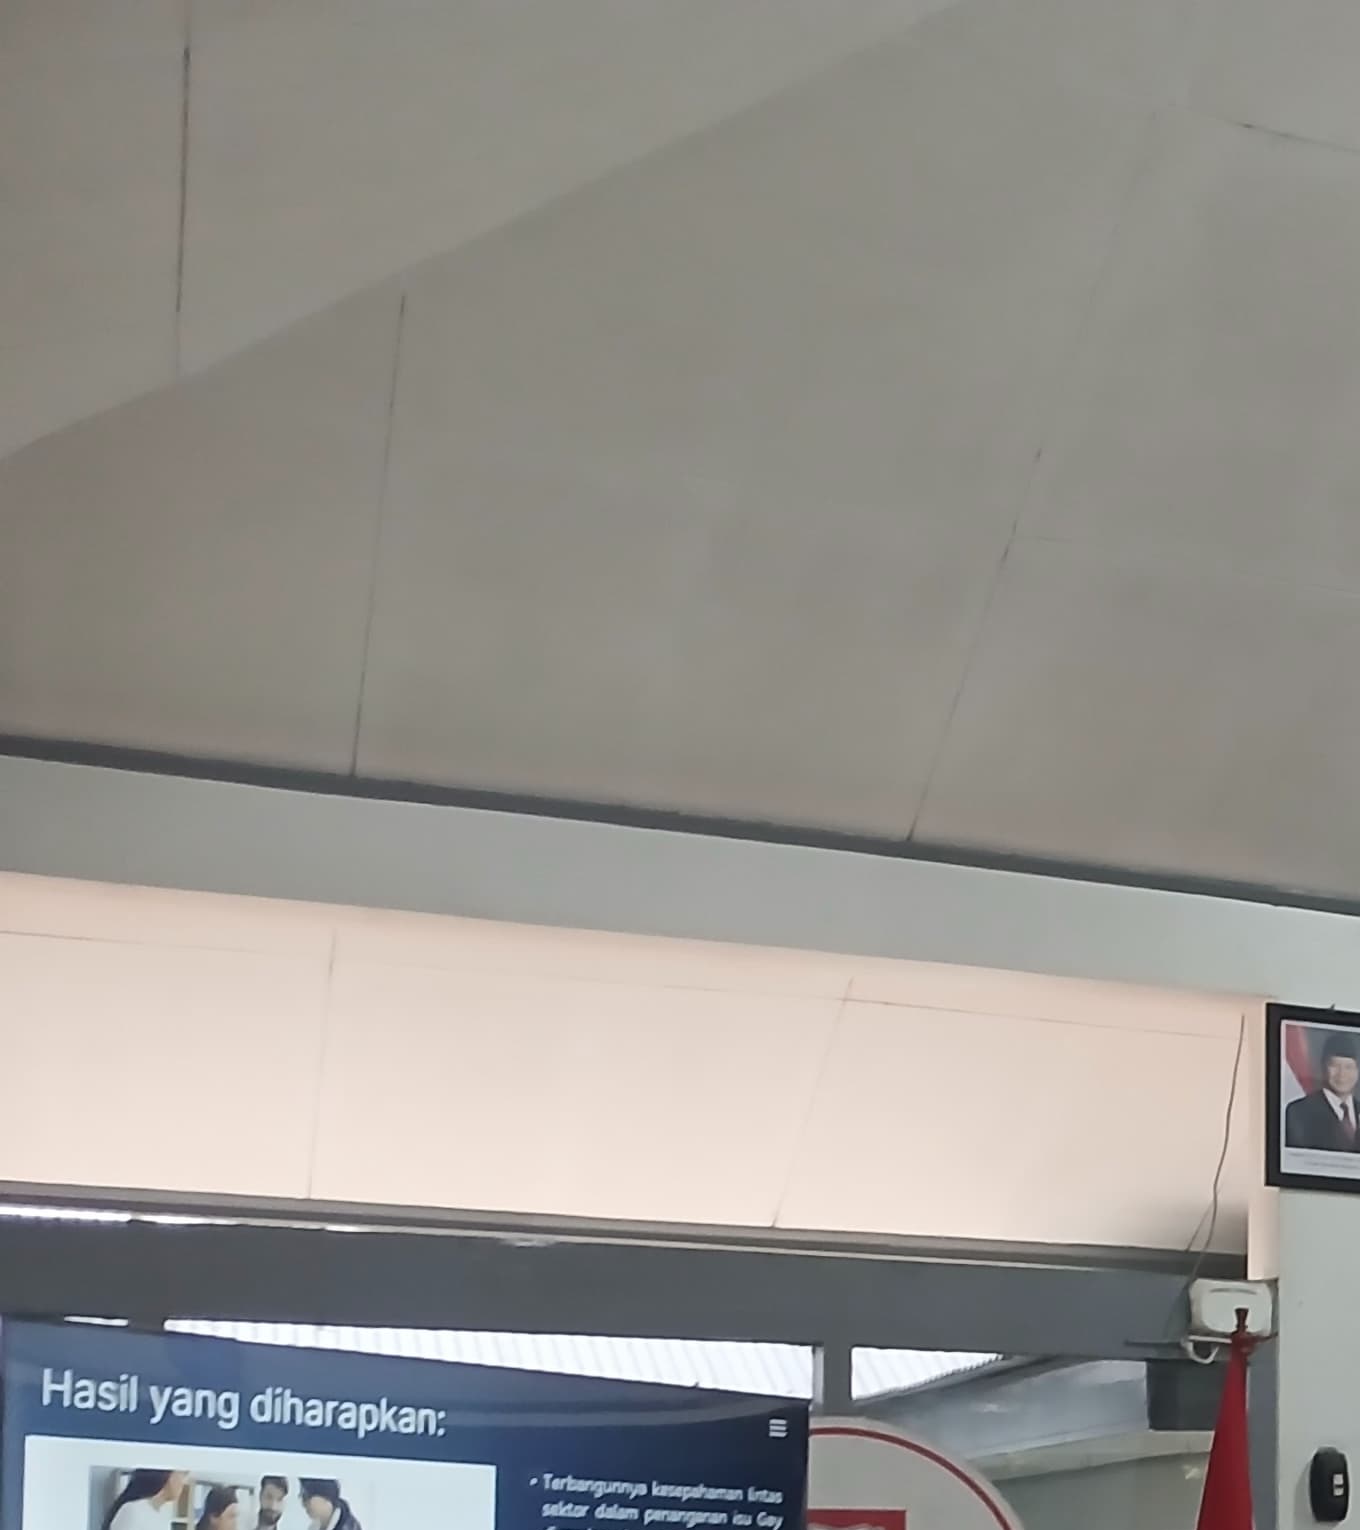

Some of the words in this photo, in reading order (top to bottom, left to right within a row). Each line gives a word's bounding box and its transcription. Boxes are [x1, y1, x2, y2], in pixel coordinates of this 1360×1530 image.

[42, 1367, 138, 1413] Hasil
[149, 1383, 240, 1429] yang
[250, 1386, 446, 1438] diharapkan:
[543, 1473, 647, 1499] Terbangunnya
[748, 1486, 783, 1503] lintas
[542, 1501, 589, 1517] sektor
[595, 1504, 639, 1520] dalam
[644, 1509, 727, 1528] penanganan
[733, 1510, 752, 1525] isu
[756, 1512, 784, 1530] Gay
